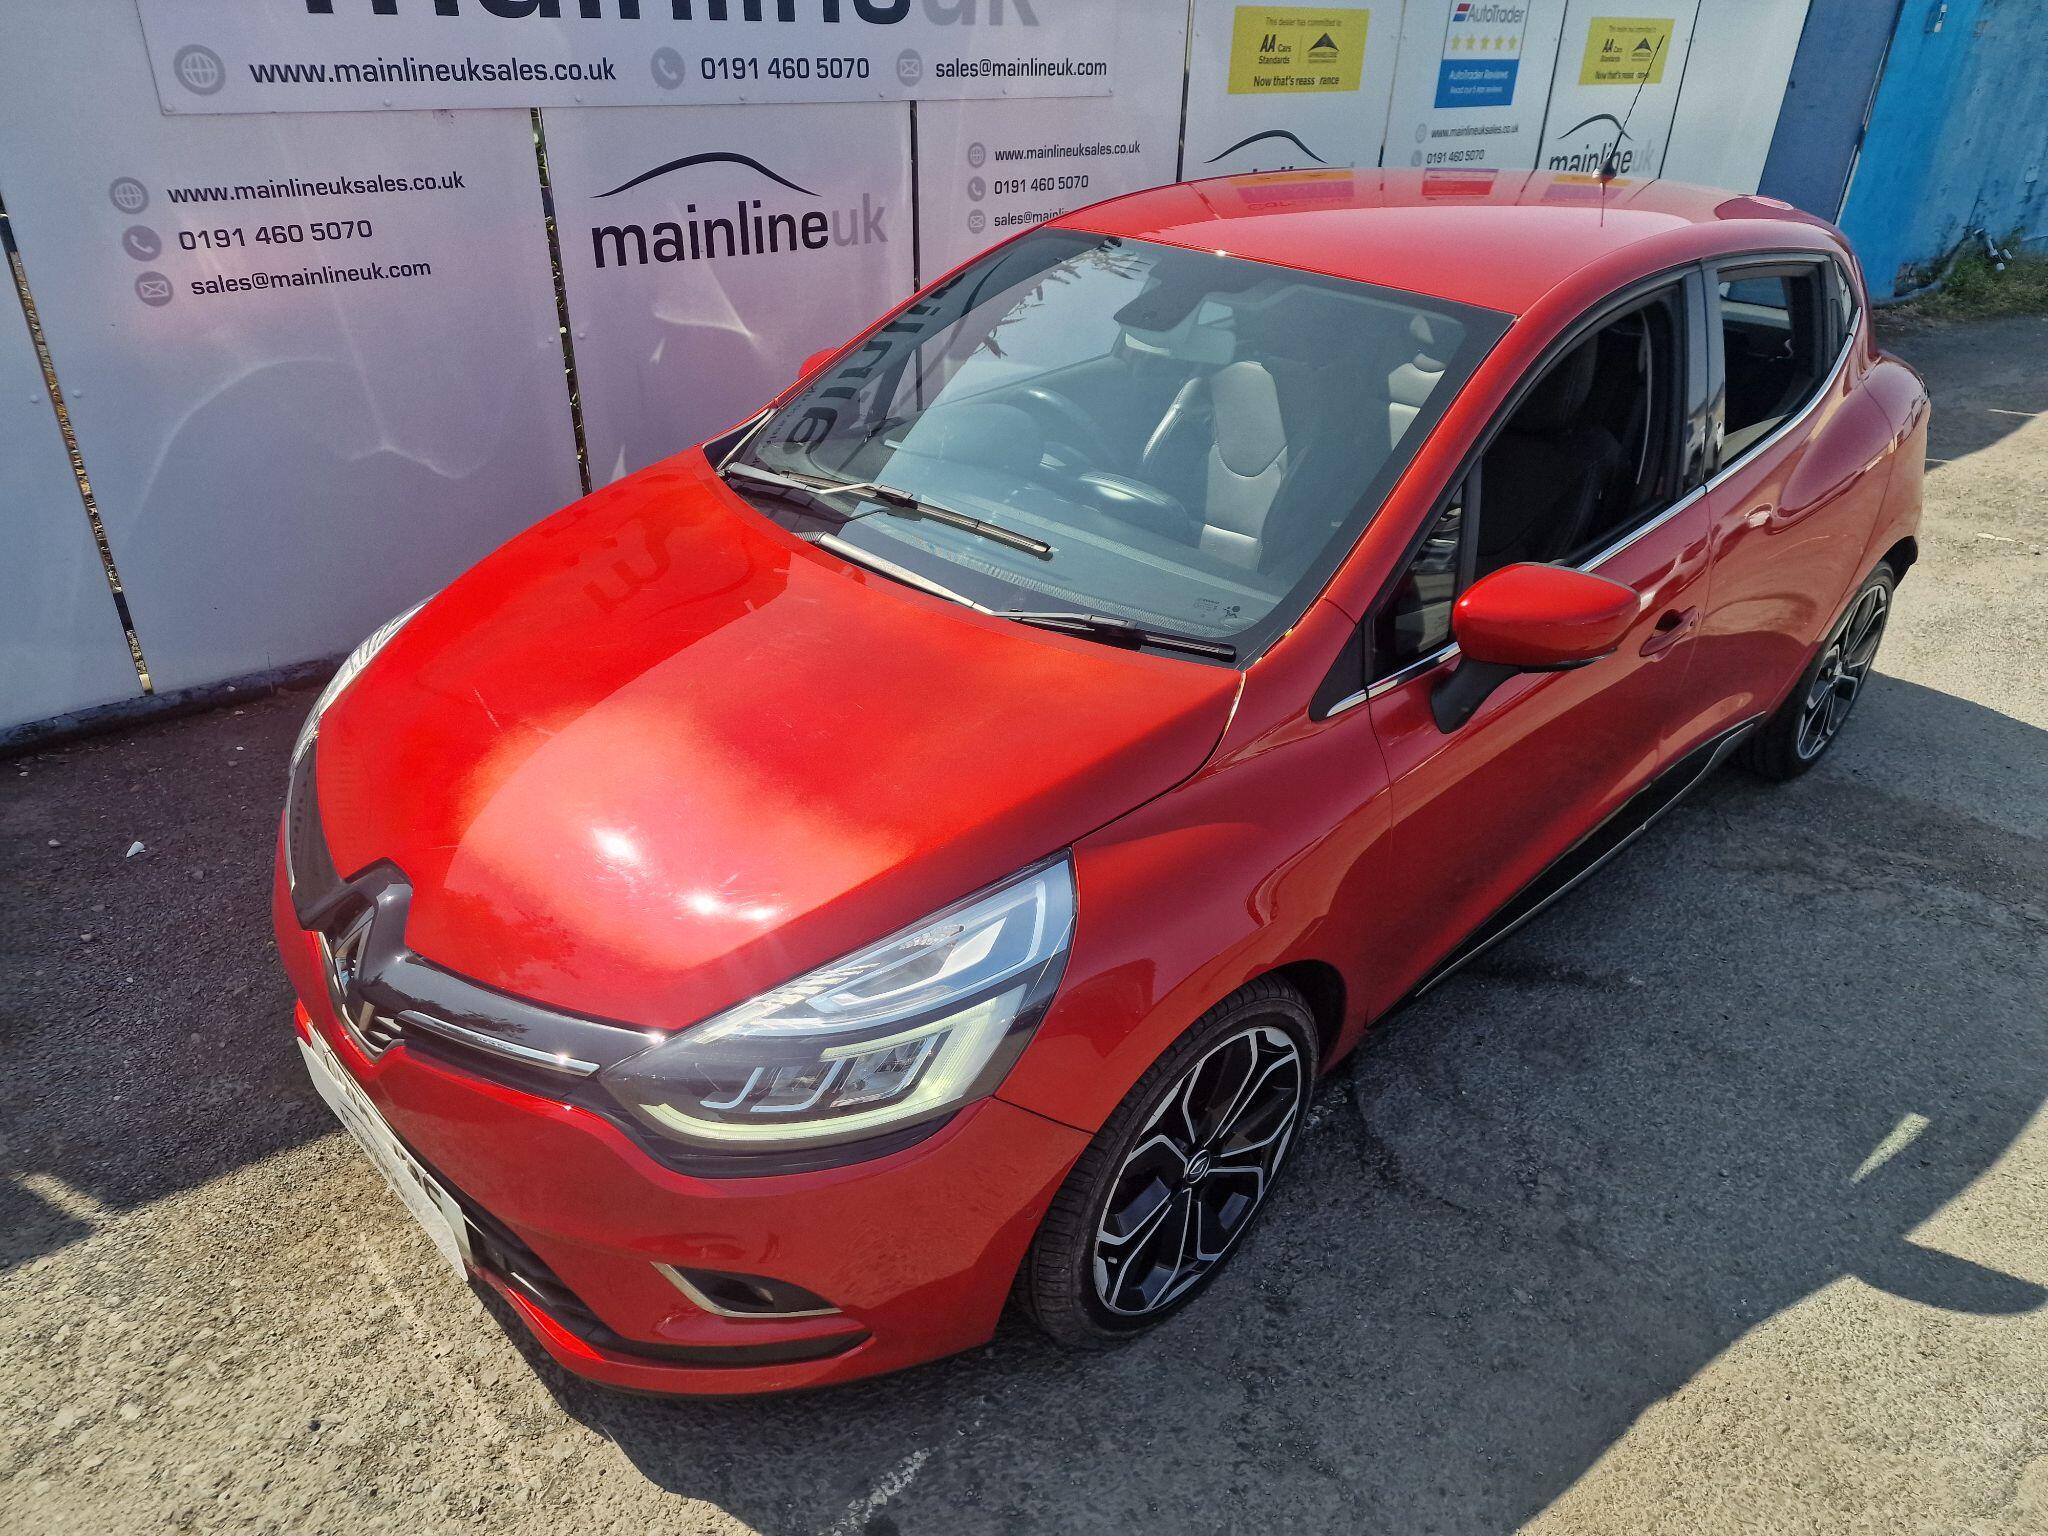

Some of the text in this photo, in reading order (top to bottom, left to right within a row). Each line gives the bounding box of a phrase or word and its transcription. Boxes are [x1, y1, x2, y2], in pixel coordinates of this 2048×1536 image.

[1468, 4, 1525, 23] AutoTrader
[1260, 34, 1276, 52] AA
[701, 57, 870, 79] 0191 460 5070
[935, 57, 1107, 78] sales@mainlineuk.com
[1258, 55, 1290, 64] Standards
[249, 57, 617, 83] www.mainlineuksales.co.uk
[1254, 76, 1271, 87] Now
[1273, 75, 1294, 86] that's
[995, 141, 1140, 161] www.mainlineuksales.co.uk
[1427, 149, 1485, 164] 0191 460 5070
[167, 171, 465, 203] www.mainlineuksales.co.uk
[994, 175, 1089, 194] 0191 460 5070
[178, 220, 373, 250] 0191 460 5070
[191, 262, 431, 295] sales@mainlineuk.com
